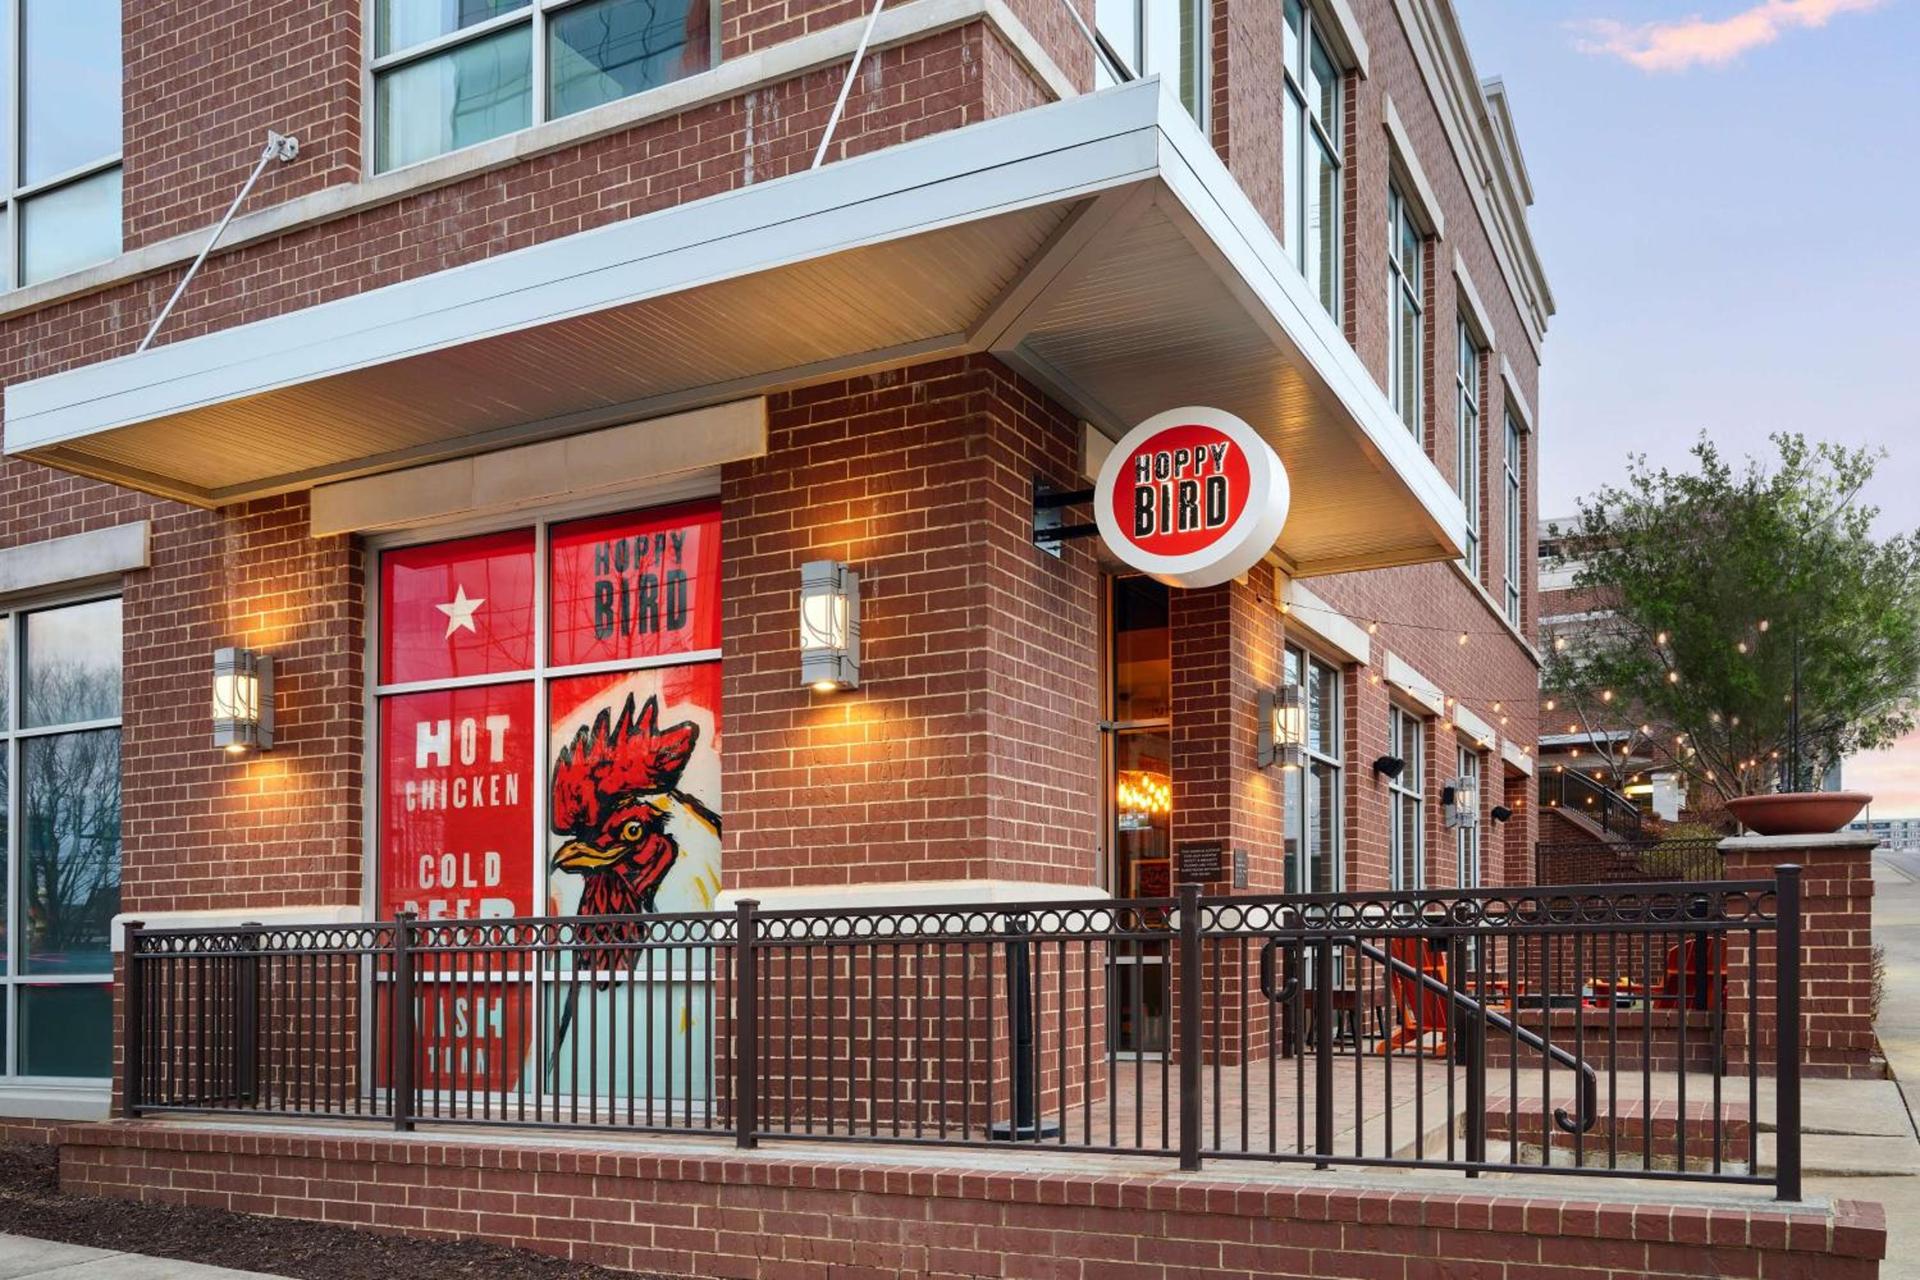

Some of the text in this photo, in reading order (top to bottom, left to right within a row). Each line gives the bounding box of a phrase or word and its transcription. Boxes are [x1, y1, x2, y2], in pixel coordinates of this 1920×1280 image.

[1135, 441, 1229, 485] HOPPY
[1134, 475, 1228, 538] BIRD
[594, 530, 687, 576] HOPPY
[594, 569, 687, 639] BIRD
[416, 715, 510, 768] HOT
[405, 773, 518, 812] CHICKEN
[419, 852, 501, 889] COLD
[414, 997, 503, 1039] ASH
